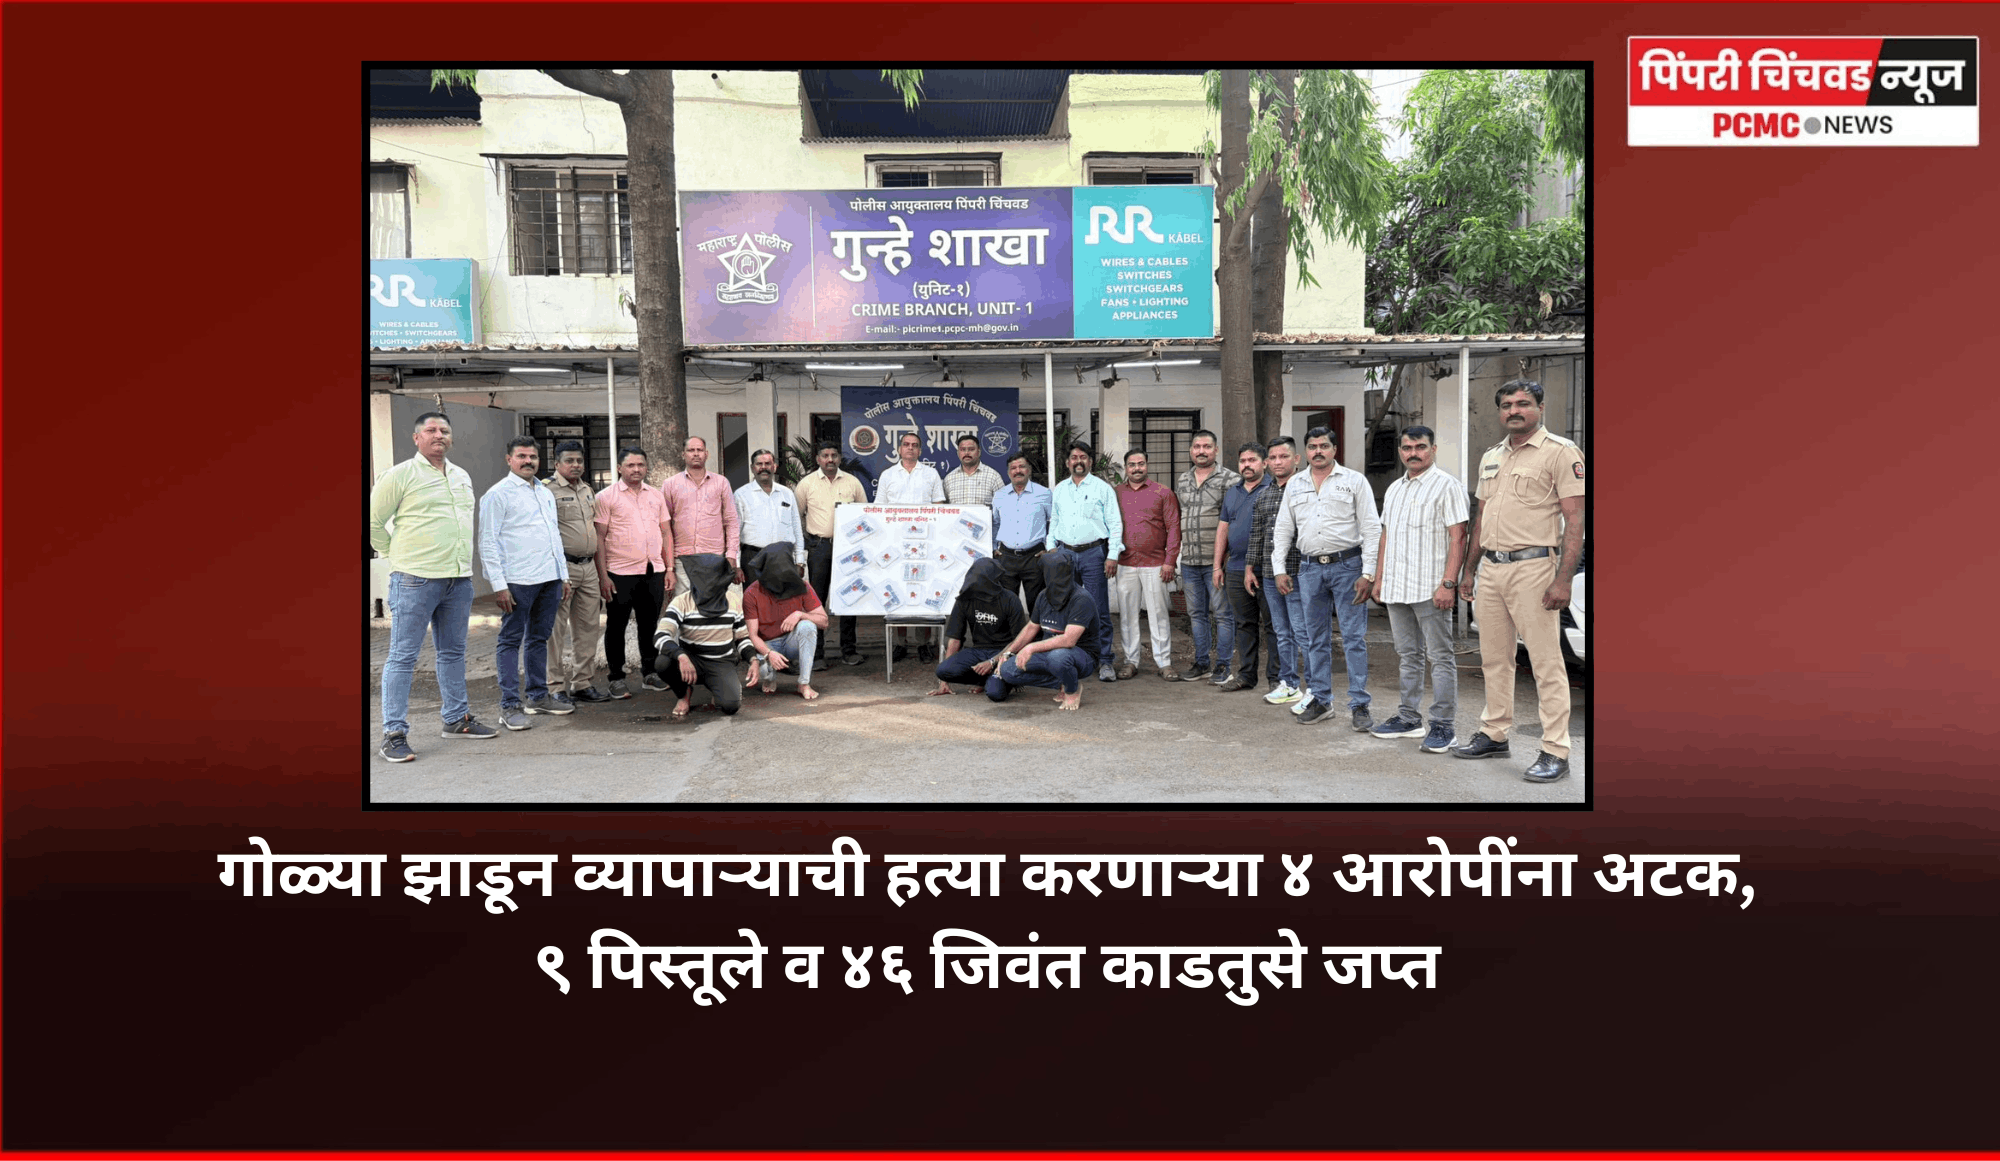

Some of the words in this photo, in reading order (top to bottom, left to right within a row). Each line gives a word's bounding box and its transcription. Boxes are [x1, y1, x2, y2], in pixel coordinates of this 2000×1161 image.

[850, 198, 886, 211] पोलीस
[890, 200, 953, 215] आयुक्तालय
[955, 196, 986, 210] पिंपरी
[989, 196, 1029, 210] चिंचवड
[1084, 205, 1164, 244] RR
[696, 235, 738, 253] महाराष्ट्र
[753, 231, 793, 253] पोलीस
[830, 215, 914, 282] गुन्हे
[928, 228, 1050, 266] शाखा
[1101, 258, 1135, 267] WIRES
[1138, 258, 1145, 266] &
[1147, 257, 1189, 266] CABLES
[1117, 270, 1173, 280] SWITCHES
[913, 280, 971, 300] (युनिट-१)
[1106, 284, 1184, 294] SWITCHGEARS
[851, 303, 900, 316] CRIME
[904, 302, 973, 317] BRANCH,
[1025, 301, 1033, 314] 1
[1101, 298, 1129, 307] FANS
[1139, 297, 1189, 306] LIGHTING
[1112, 310, 1178, 320] APPLIANCES
[864, 401, 890, 420] पोलीस
[893, 394, 940, 410] आयुक्तालय
